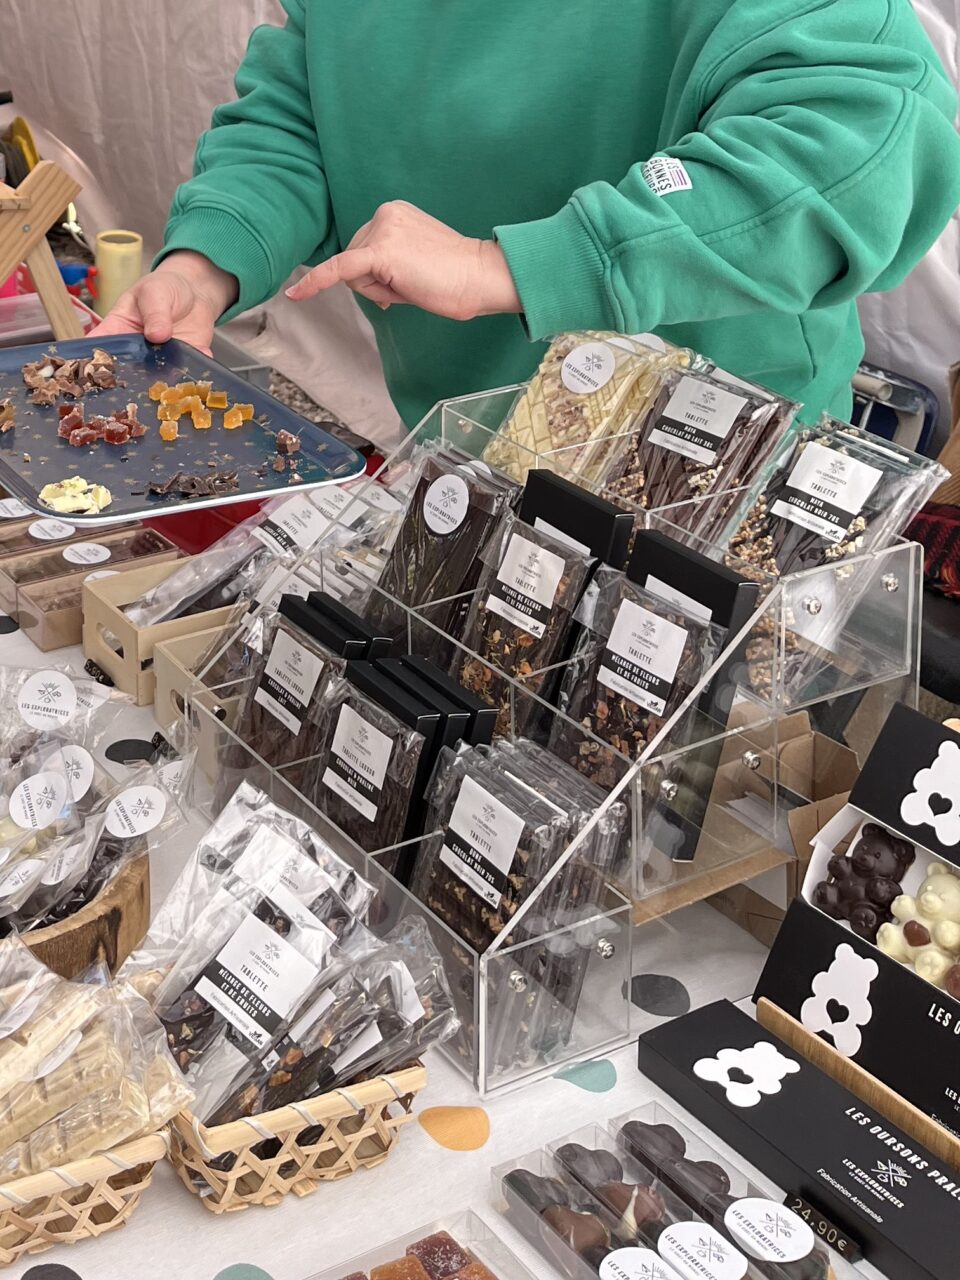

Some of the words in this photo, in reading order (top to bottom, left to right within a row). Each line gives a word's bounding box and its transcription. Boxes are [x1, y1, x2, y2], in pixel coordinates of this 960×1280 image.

[650, 159, 672, 191] BONNES
[685, 412, 708, 426] TABLETTE
[661, 424, 685, 437] CHOCOLAT
[811, 482, 837, 498] TABLETTE
[788, 496, 814, 513] CHOCOLAT
[814, 506, 827, 518] NOIR
[810, 497, 824, 507] MAYA
[515, 577, 537, 593] TABLETTE
[515, 602, 532, 615] FRUITS
[524, 597, 542, 611] FLEURS
[628, 646, 652, 665] TABLETTE
[616, 666, 623, 674] ET
[624, 670, 631, 679] DE
[631, 674, 650, 690] FRUITS
[632, 665, 639, 673] DE
[640, 669, 660, 686] FLEURS
[31, 704, 70, 717] EXPLORATRICES
[342, 745, 359, 763] TABLETTE
[470, 830, 492, 853] TABLETTE
[452, 843, 473, 866] CHOCOLAT
[473, 861, 485, 876] NOIR
[240, 964, 269, 992] TABLETTE
[218, 968, 241, 990] MÉLANGE
[241, 987, 249, 997] DE
[249, 994, 272, 1017] FLEURS
[220, 982, 228, 991] ET
[228, 988, 236, 998] DE
[235, 995, 258, 1018] FRUITS
[928, 1003, 952, 1027] LES
[945, 1087, 957, 1100] LES
[844, 1107, 871, 1126] LES
[869, 1125, 929, 1170] OURSONS
[927, 1170, 960, 1201] PRAL
[842, 1159, 856, 1169] LES
[854, 1168, 905, 1208] EXPLORATRICES
[816, 1168, 851, 1198] Fabrication
[851, 1196, 884, 1223] Artisanale
[732, 1209, 744, 1220] LES
[743, 1219, 786, 1258] EXPLORATRICES
[791, 1198, 848, 1251] 24,90€
[665, 1233, 677, 1245] LES
[607, 1260, 620, 1271] LES
